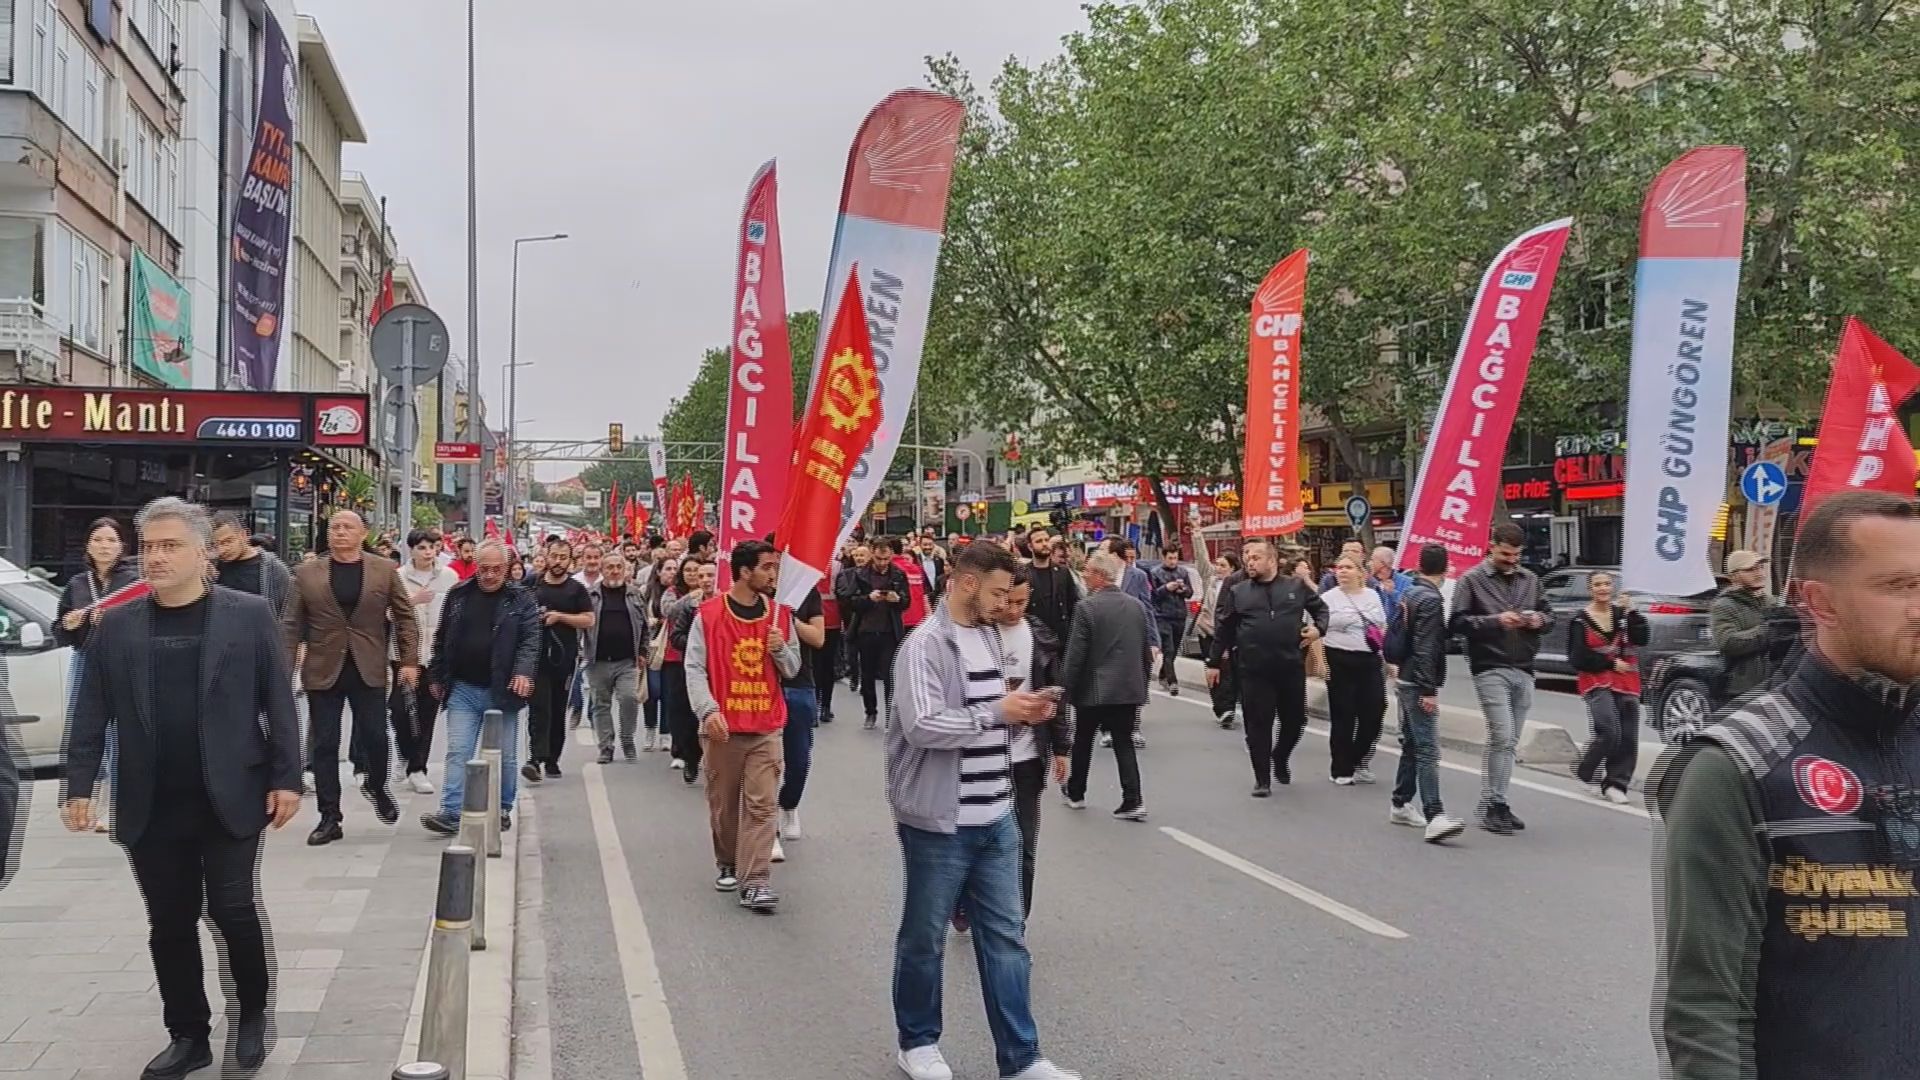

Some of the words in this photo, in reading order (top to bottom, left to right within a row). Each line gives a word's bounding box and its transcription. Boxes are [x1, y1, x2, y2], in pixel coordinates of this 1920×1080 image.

[1503, 271, 1533, 288] CHP
[1256, 313, 1302, 338] CHP
[730, 249, 765, 533] BAĞCILAR
[1661, 297, 1710, 479] GÜNGÖREN
[83, 394, 186, 434] Mantı
[1440, 294, 1521, 524] BAĞCILAR
[216, 422, 247, 439] 466
[251, 422, 261, 439] 0
[266, 422, 296, 439] 100
[1523, 478, 1551, 498] PİDE
[1655, 485, 1689, 561] CHP
[730, 681, 769, 695] EMEK
